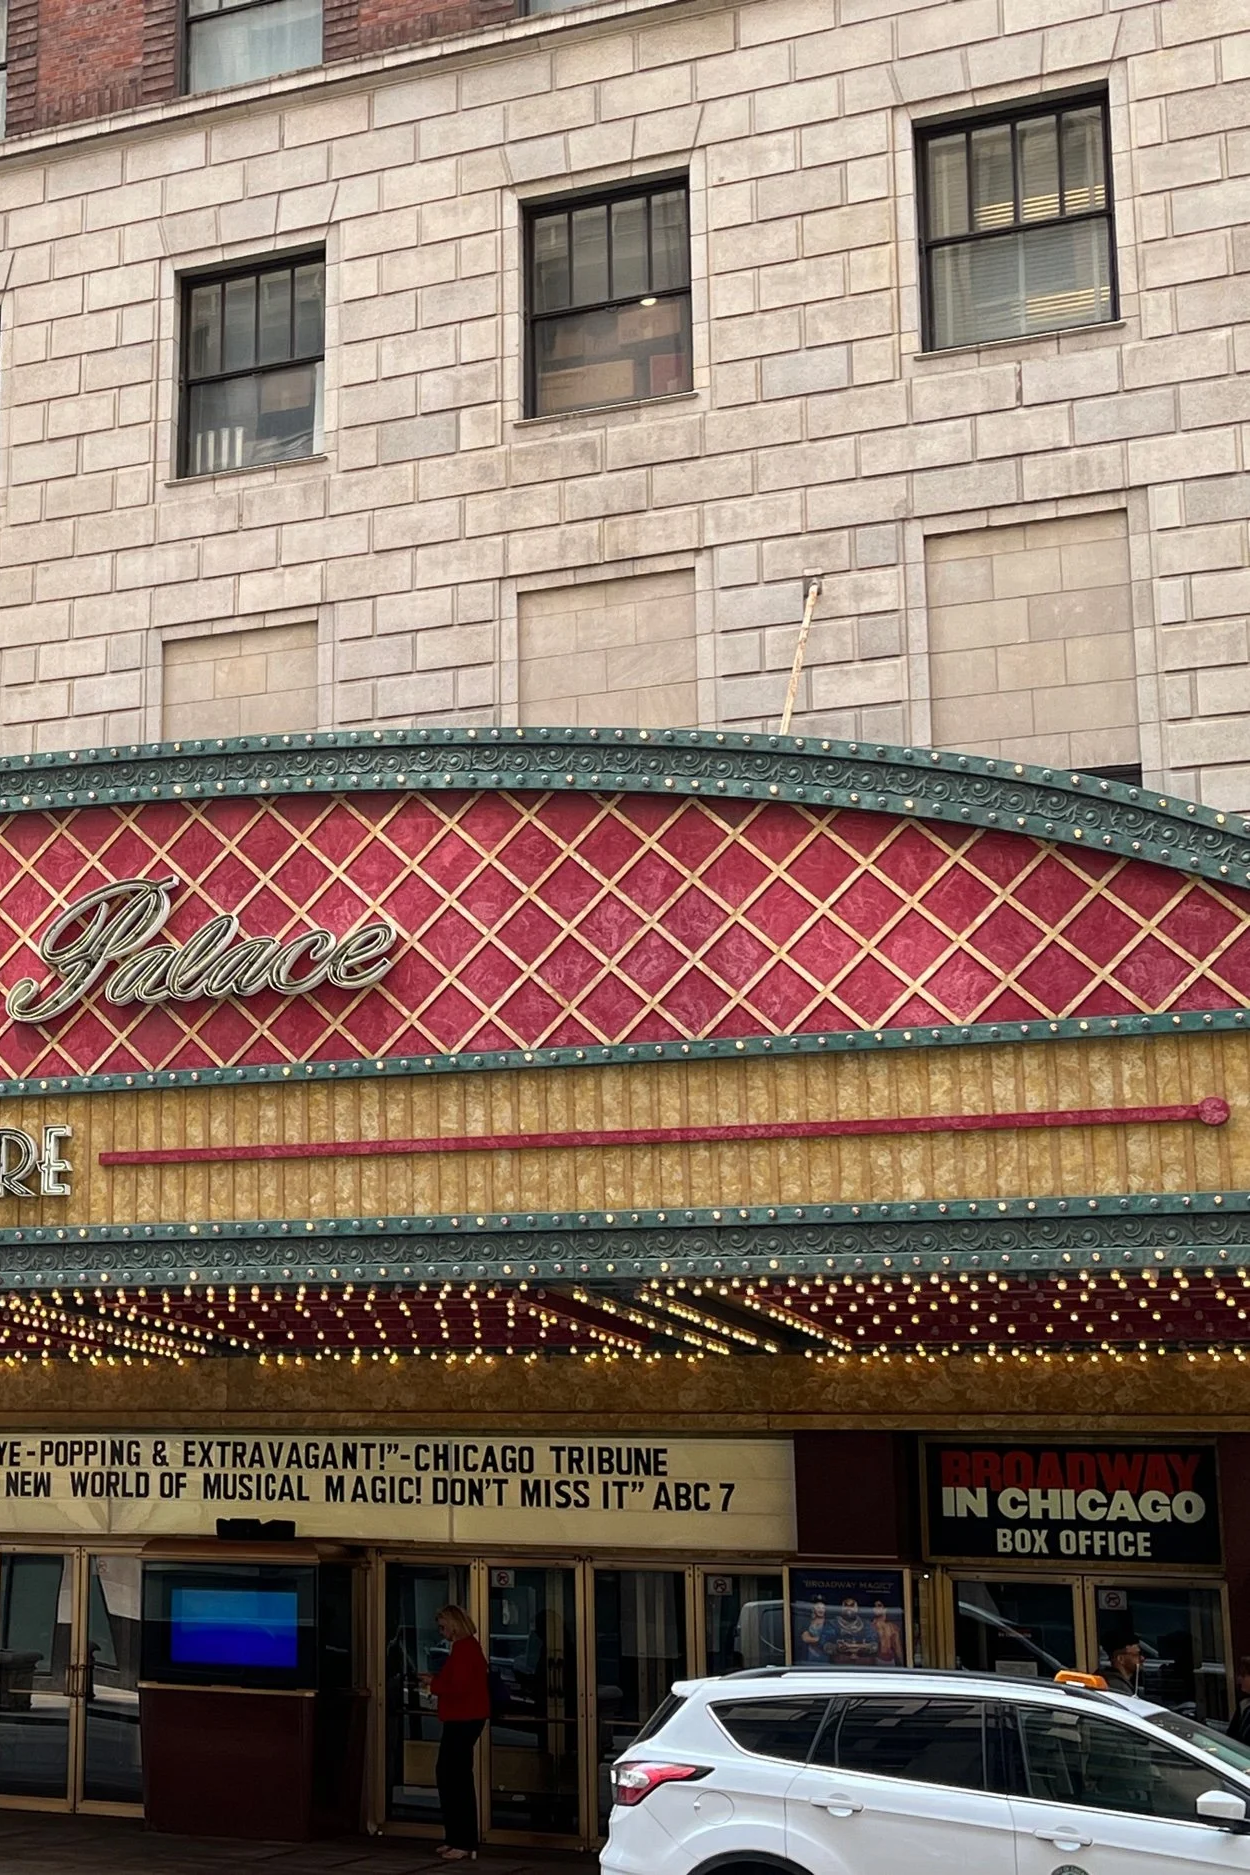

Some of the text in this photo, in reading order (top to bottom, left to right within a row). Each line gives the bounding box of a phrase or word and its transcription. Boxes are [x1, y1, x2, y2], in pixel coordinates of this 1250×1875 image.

[5, 873, 398, 1024] Palace
[152, 1440, 169, 1467] &
[549, 1446, 668, 1477] TRIBUNE
[941, 1451, 1201, 1494] BROADWAY
[6, 1471, 51, 1497] NEW
[70, 1472, 150, 1498] WORLD
[159, 1472, 187, 1499] OF
[203, 1473, 310, 1501] MUSICAL
[325, 1475, 422, 1505] MAGIC!
[432, 1478, 508, 1506] DON'T
[520, 1479, 590, 1508] MISS
[652, 1482, 711, 1511] ABC
[719, 1483, 735, 1511] 7
[942, 1487, 1206, 1523] IN CHICAGO
[996, 1528, 1152, 1556] BOX OFFICE
